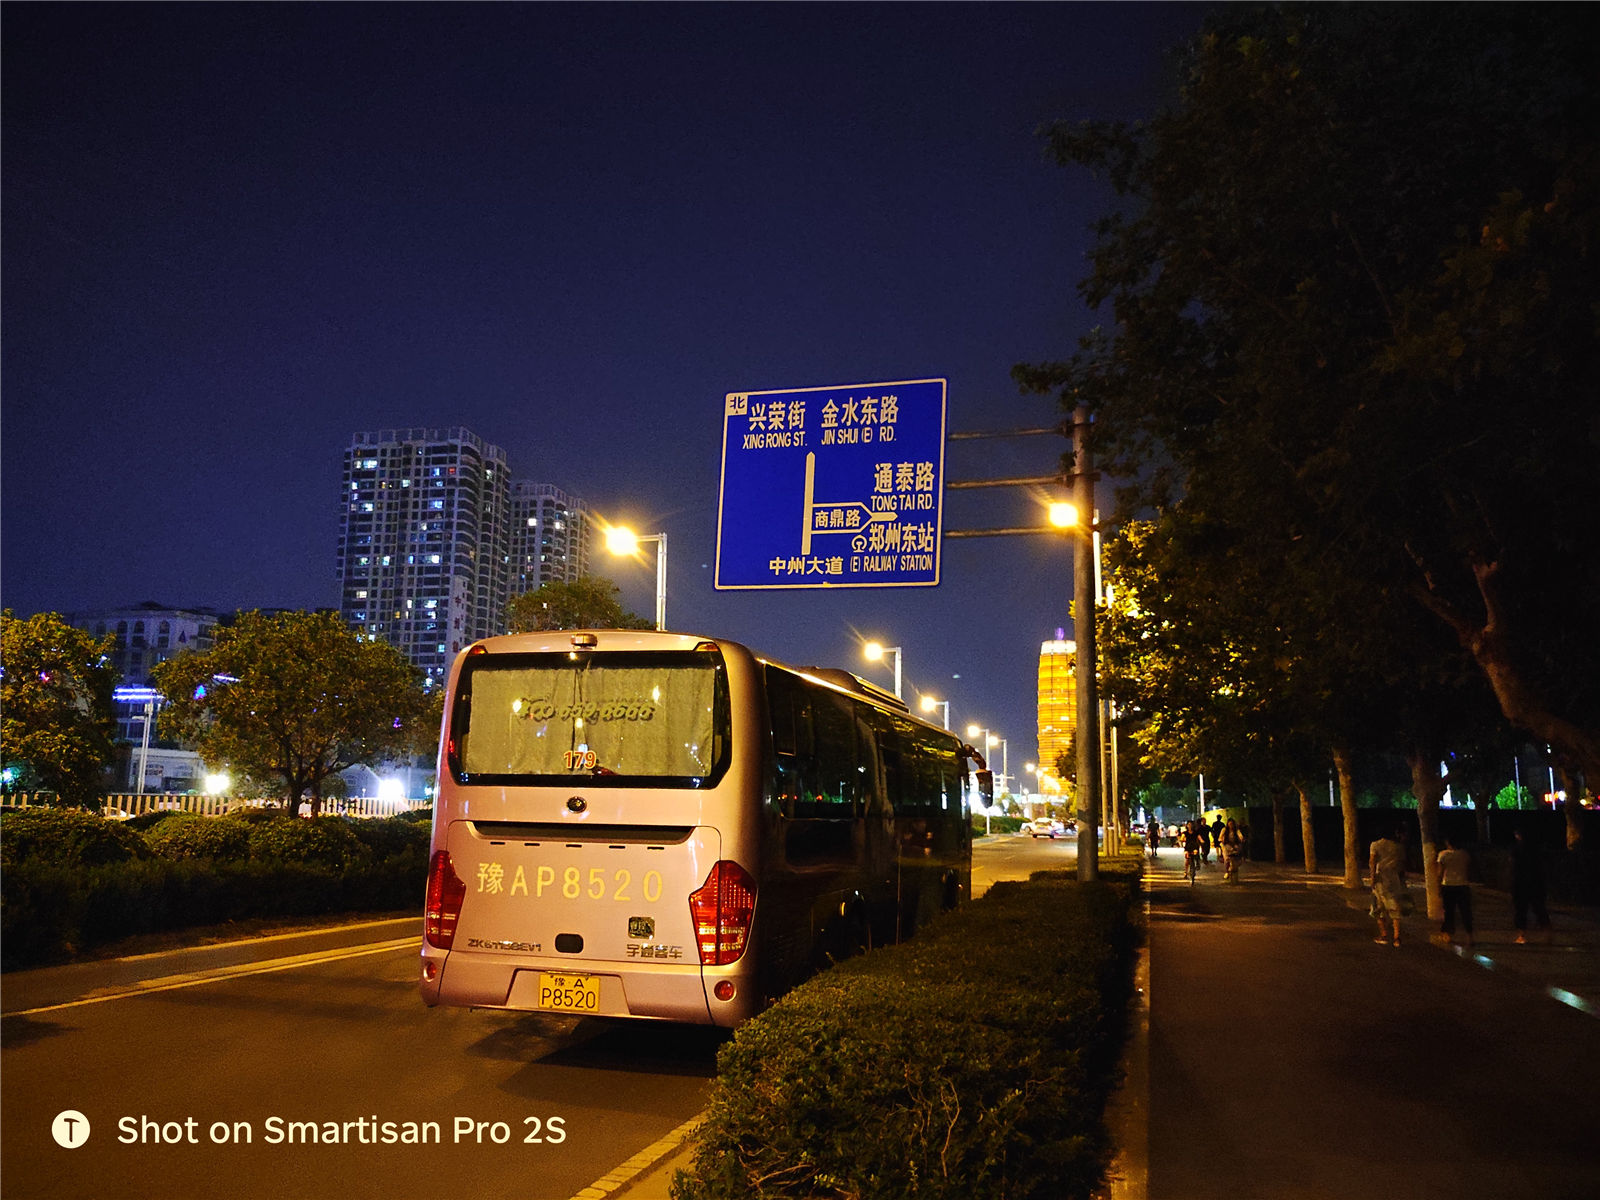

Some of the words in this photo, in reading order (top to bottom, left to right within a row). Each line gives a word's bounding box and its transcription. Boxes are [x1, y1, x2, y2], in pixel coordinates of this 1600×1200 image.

[729, 395, 745, 410] 北
[748, 400, 806, 431] 兴荣街
[821, 395, 899, 428] 金水东路
[742, 433, 764, 450] XING
[766, 432, 791, 449] RONG
[793, 431, 808, 447] ST.
[821, 428, 835, 446] JIN
[837, 428, 859, 445] SHUI
[861, 427, 873, 443] (E)
[880, 426, 897, 442] RD.
[874, 461, 935, 493] 通泰路
[871, 495, 897, 511] TONG
[899, 494, 915, 511] TAI
[917, 493, 935, 510] RD.
[815, 509, 861, 528] 商鼎路
[869, 521, 934, 553] 郑州东站
[769, 556, 844, 576] 中州大道
[850, 556, 861, 573] (E)
[863, 555, 897, 572] RAILWAY
[900, 554, 933, 571] STATION
[563, 751, 597, 769] 179
[477, 862, 663, 902] 豫AP8520
[626, 943, 683, 959] 宇通客车
[541, 987, 596, 1009] P8520
